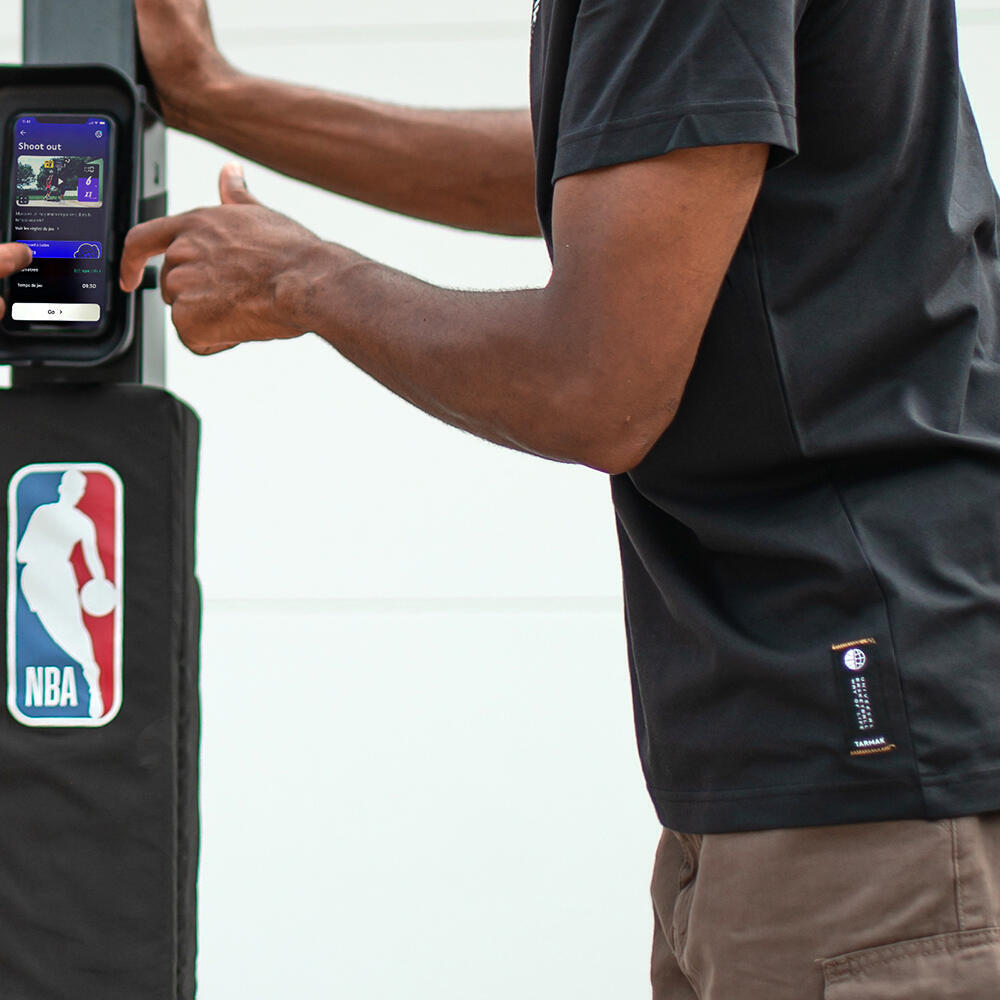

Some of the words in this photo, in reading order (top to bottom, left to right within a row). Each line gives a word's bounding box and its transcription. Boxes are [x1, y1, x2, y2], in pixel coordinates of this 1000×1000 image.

[18, 142, 44, 151] Shoot
[46, 143, 62, 151] out
[24, 666, 79, 708] NBA
[854, 737, 886, 748] TARMAK
